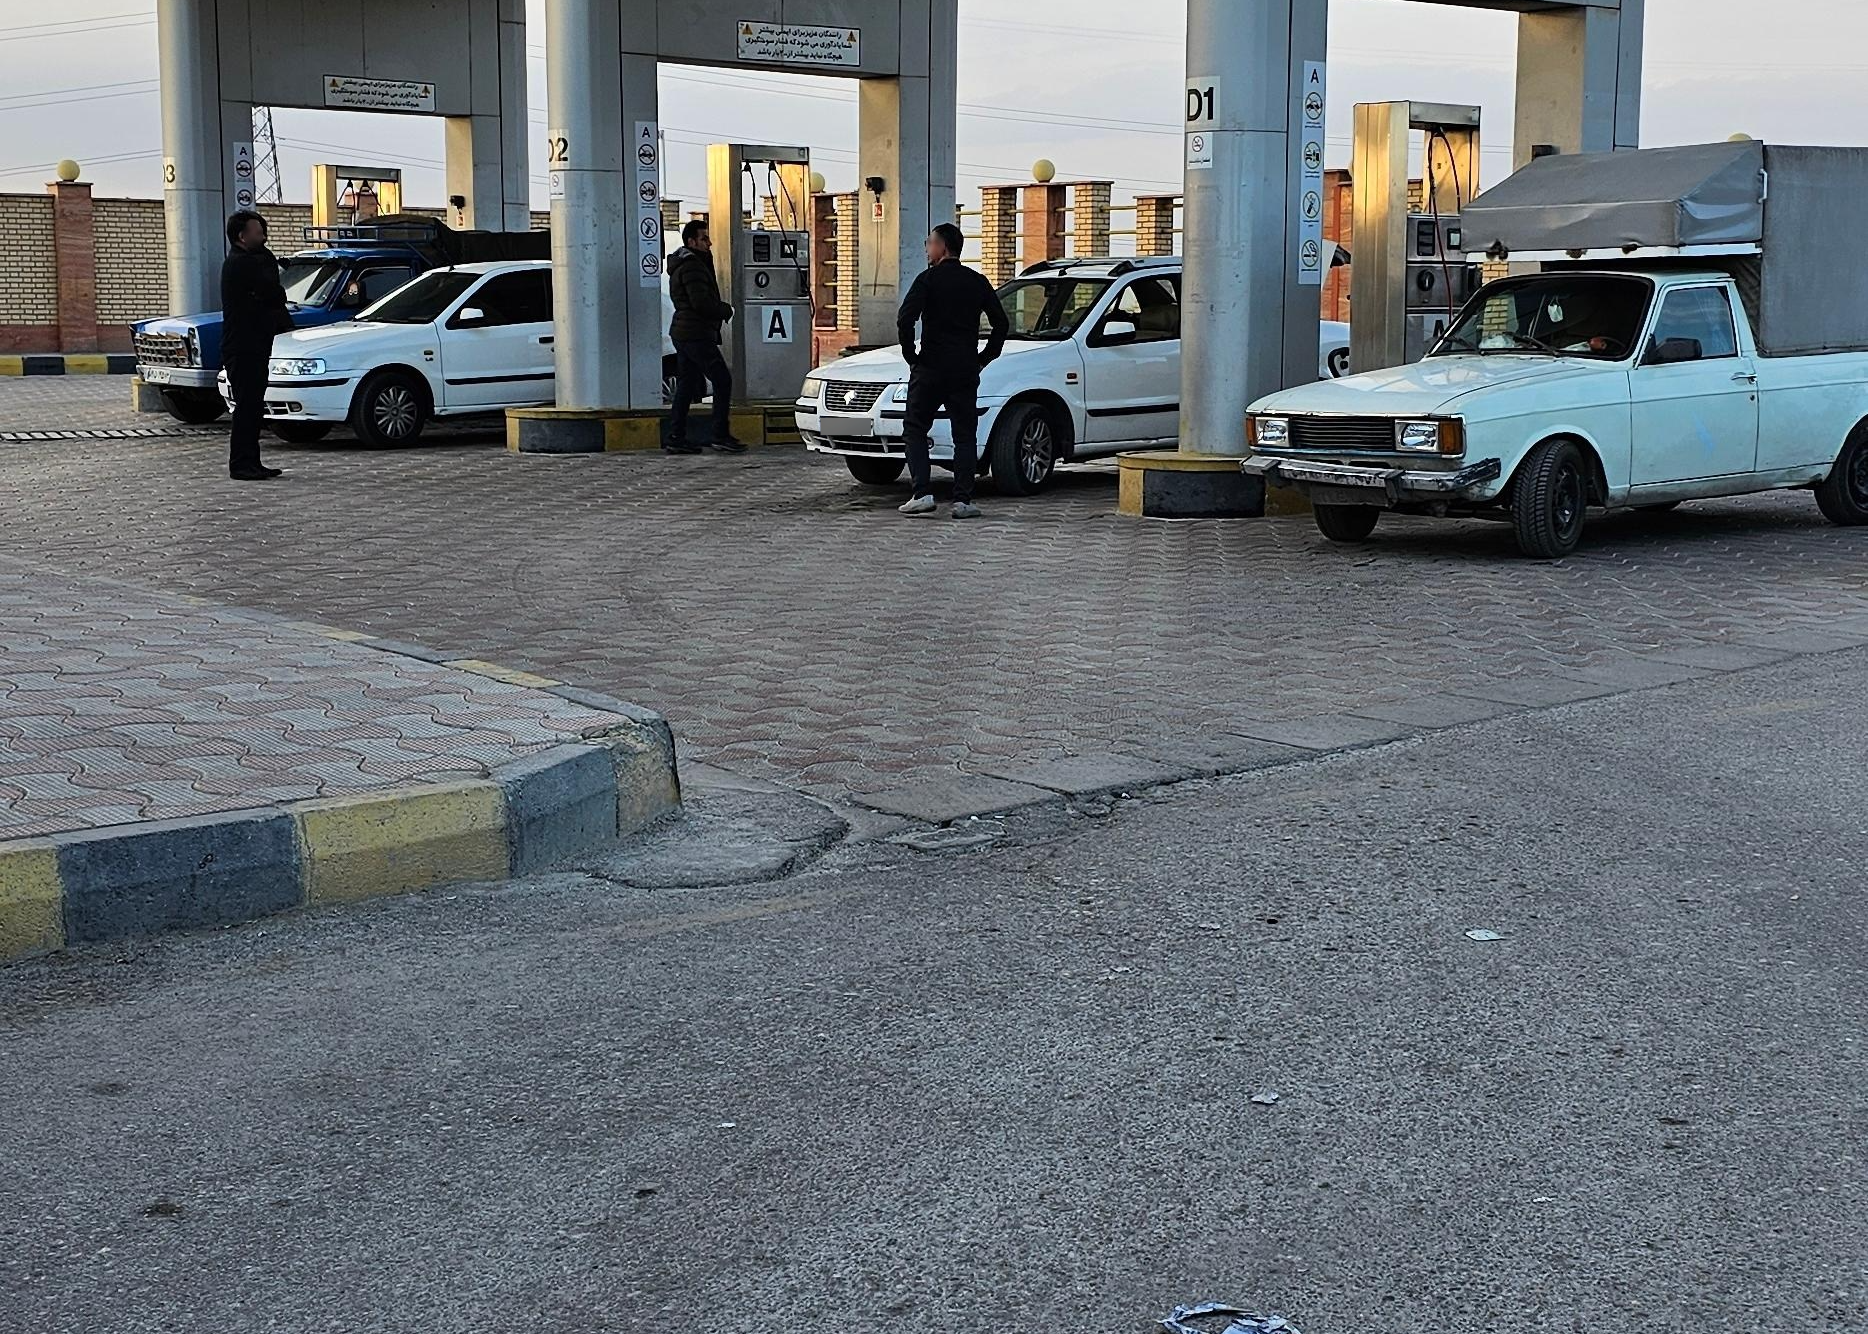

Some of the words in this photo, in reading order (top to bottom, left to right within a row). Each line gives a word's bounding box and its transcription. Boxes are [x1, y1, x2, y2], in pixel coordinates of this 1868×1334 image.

[1310, 68, 1320, 84] A
[1187, 87, 1214, 122] D1
[641, 126, 651, 138] A
[239, 146, 248, 156] A
[163, 164, 176, 183] 3
[767, 309, 787, 339] A
